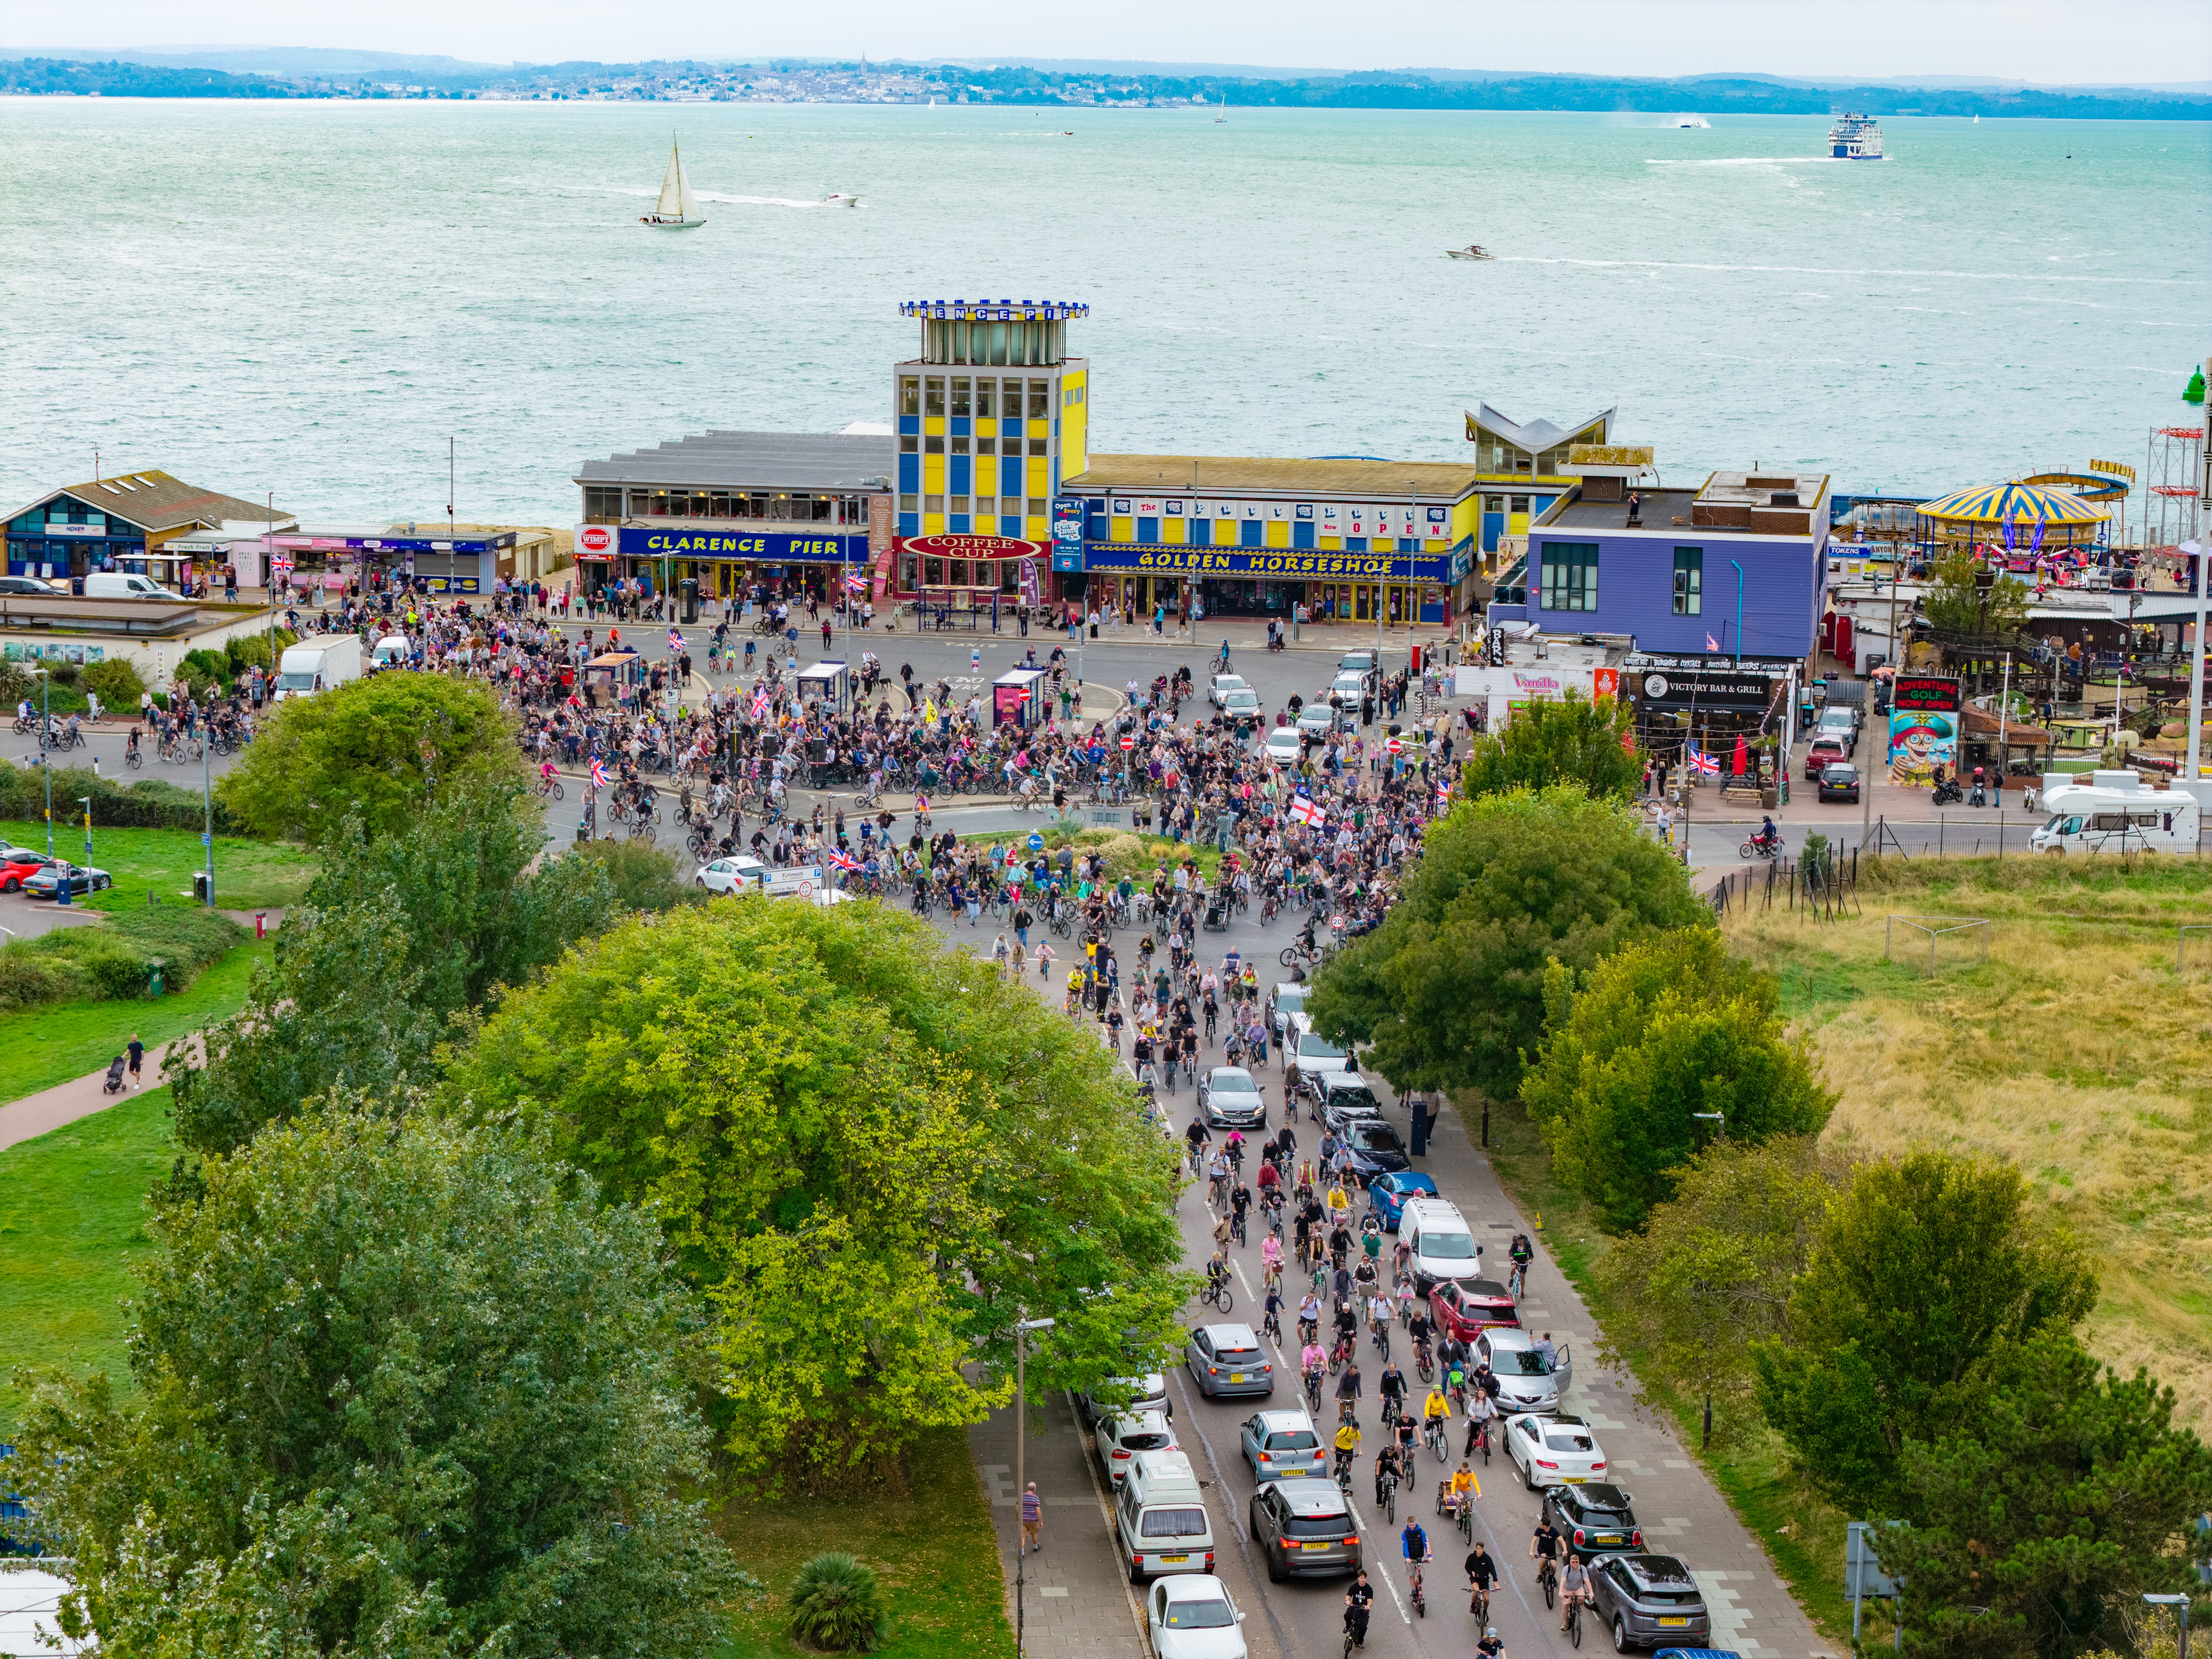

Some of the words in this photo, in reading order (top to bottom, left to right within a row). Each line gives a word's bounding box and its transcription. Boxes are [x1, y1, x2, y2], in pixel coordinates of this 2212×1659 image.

[1026, 308, 1081, 319] PIER
[648, 536, 765, 552] CLARENCE
[790, 540, 838, 554] PIER
[928, 537, 1015, 549] COFFEE
[950, 548, 994, 558] CUP
[1139, 553, 1230, 568] GOLDEN
[1250, 556, 1394, 573] HORSESHOE
[1492, 629, 1502, 656] BAR
[1653, 659, 1677, 667] BURGERS
[1736, 662, 1760, 670] BEERS
[1512, 672, 1559, 689] Vanilla
[1669, 683, 1708, 692] VICTORY
[1737, 686, 1763, 694] GRILL
[1896, 680, 1957, 695] ADVENTURE
[1910, 690, 1942, 700] GOLF
[1925, 701, 1953, 709] OPEN
